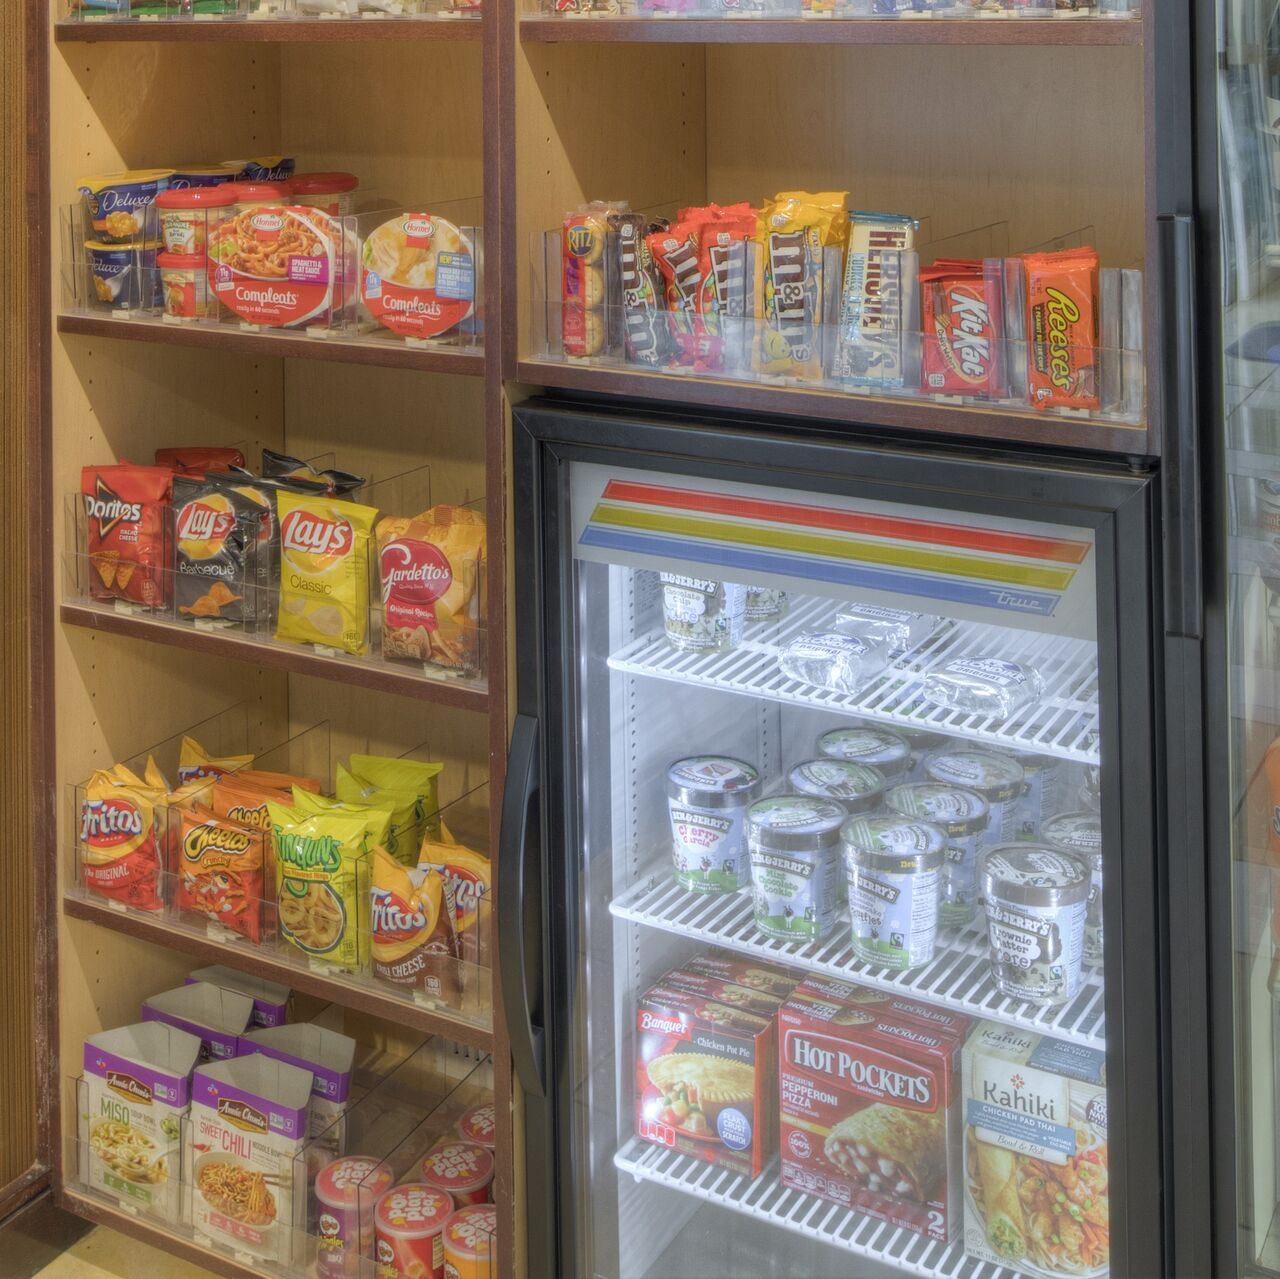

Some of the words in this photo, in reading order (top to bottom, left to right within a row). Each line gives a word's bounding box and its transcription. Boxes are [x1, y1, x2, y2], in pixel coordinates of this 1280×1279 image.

[103, 190, 152, 211] Deluxe
[255, 217, 282, 227] Hormel
[407, 223, 432, 233] Hormel
[569, 230, 594, 248] RITZ
[236, 287, 297, 306] Compleats
[382, 294, 441, 315] Compleats
[1045, 287, 1080, 392] Reese's
[85, 496, 141, 520] Doritos
[179, 503, 228, 542] Lay's
[284, 512, 350, 554] Lay's
[180, 562, 235, 577] Barbecue
[289, 574, 332, 595] Classic
[989, 588, 1044, 611] true
[389, 605, 413, 617] Original
[414, 607, 435, 620] Recipe
[80, 799, 143, 842] Fritos
[185, 824, 251, 861] Cheetos
[763, 884, 793, 897] Cookie
[371, 886, 426, 933] Fritos
[641, 1012, 689, 1036] Banquet
[697, 1036, 724, 1050] Chicken
[726, 1045, 739, 1055] Pot
[740, 1047, 751, 1058] Pie
[982, 1030, 1032, 1049] Kahiki
[782, 1072, 814, 1087] PREMIUM
[794, 1037, 835, 1074] HOT
[837, 1051, 930, 1104] POCKETS
[108, 1074, 129, 1089] Annie
[782, 1081, 838, 1105] PEPPERONI
[782, 1090, 811, 1108] PIZZA
[983, 1080, 1056, 1120] Kahiki
[100, 1097, 130, 1126] MISO
[219, 1102, 241, 1116] Annie
[982, 1106, 1018, 1120] CHICKEN
[1019, 1116, 1035, 1127] PAD
[1037, 1122, 1056, 1133] THAI
[199, 1121, 222, 1138] SWEET
[222, 1129, 252, 1160] CHILI
[928, 1210, 944, 1234] 2
[928, 1231, 945, 1241] PACK
